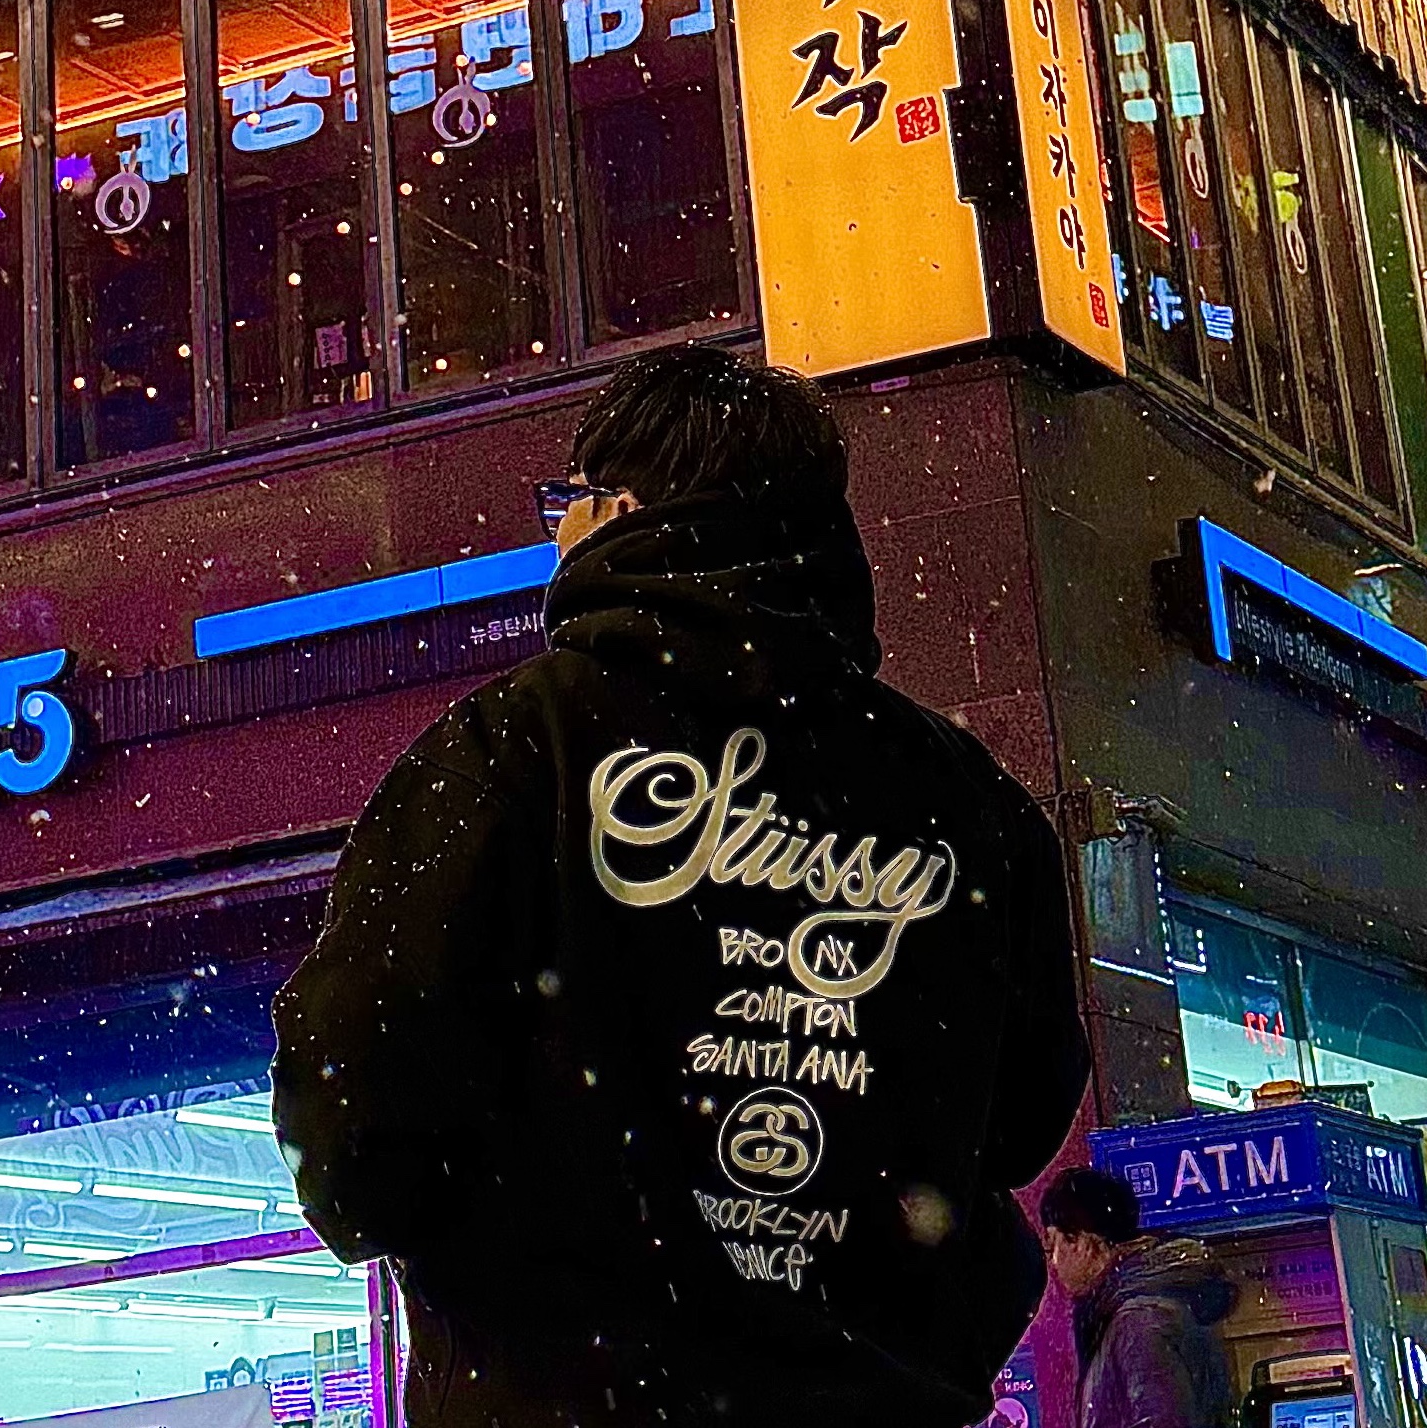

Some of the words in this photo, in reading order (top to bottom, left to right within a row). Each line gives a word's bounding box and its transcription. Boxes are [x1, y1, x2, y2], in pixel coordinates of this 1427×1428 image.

[714, 984, 857, 1038] COMPTON
[686, 1033, 790, 1081] SANTA
[795, 1049, 875, 1095] ANA
[1172, 1135, 1291, 1199] ATM
[692, 1188, 849, 1243] BROOKLYN
